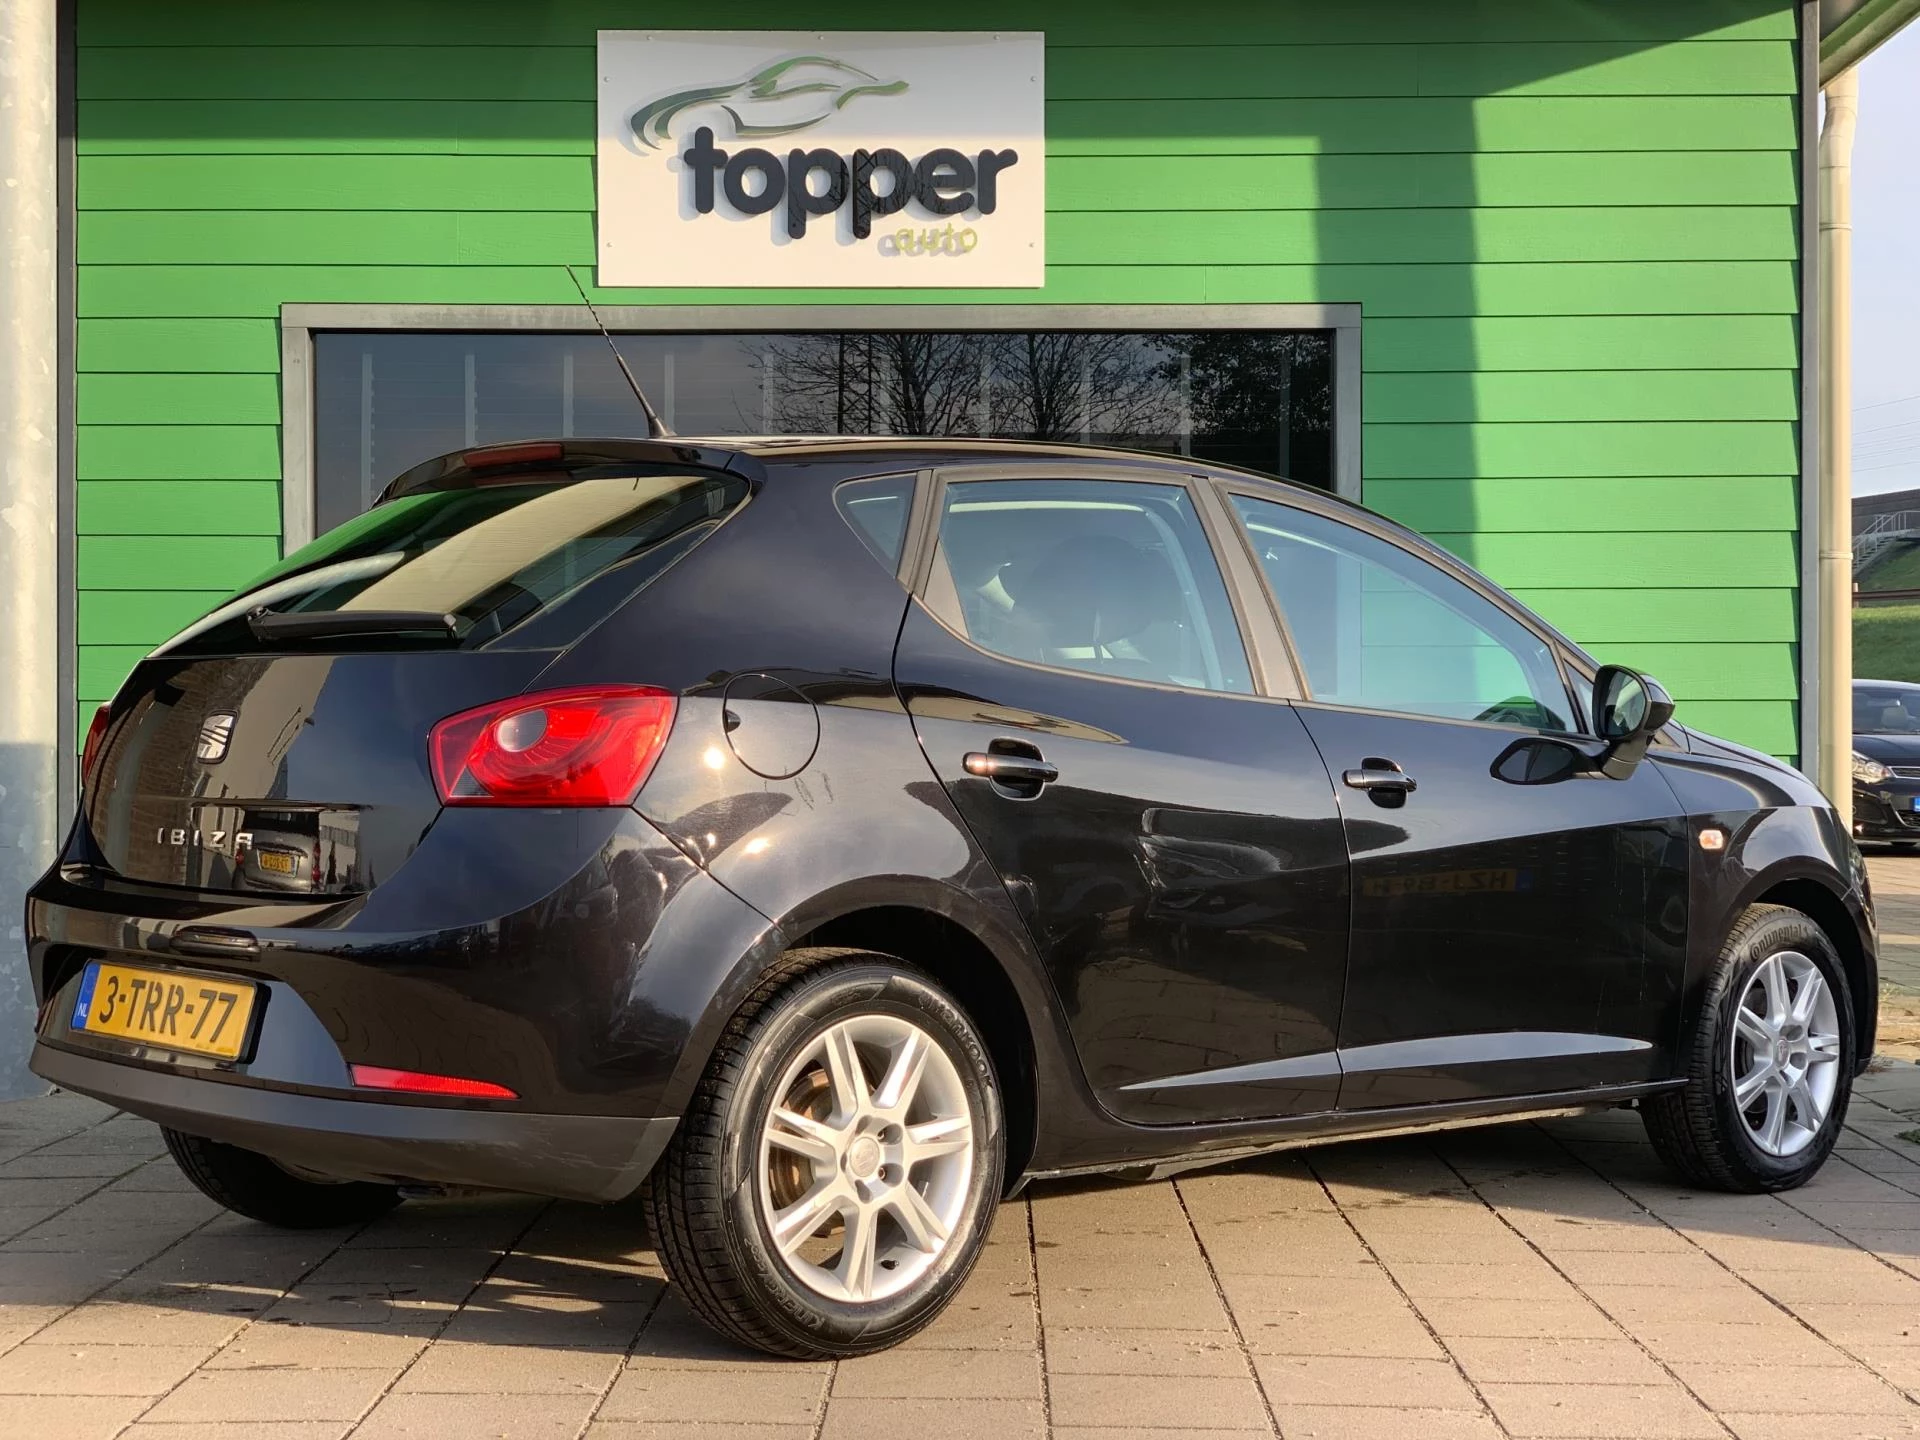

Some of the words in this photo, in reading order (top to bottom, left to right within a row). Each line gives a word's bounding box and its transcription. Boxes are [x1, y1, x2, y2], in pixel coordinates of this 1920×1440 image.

[683, 126, 1018, 239] topper
[895, 222, 978, 252] auto
[157, 827, 253, 850] IBIZA
[1750, 924, 1802, 962] Continental
[77, 1002, 88, 1017] NL
[99, 976, 238, 1043] 3-TRR-77
